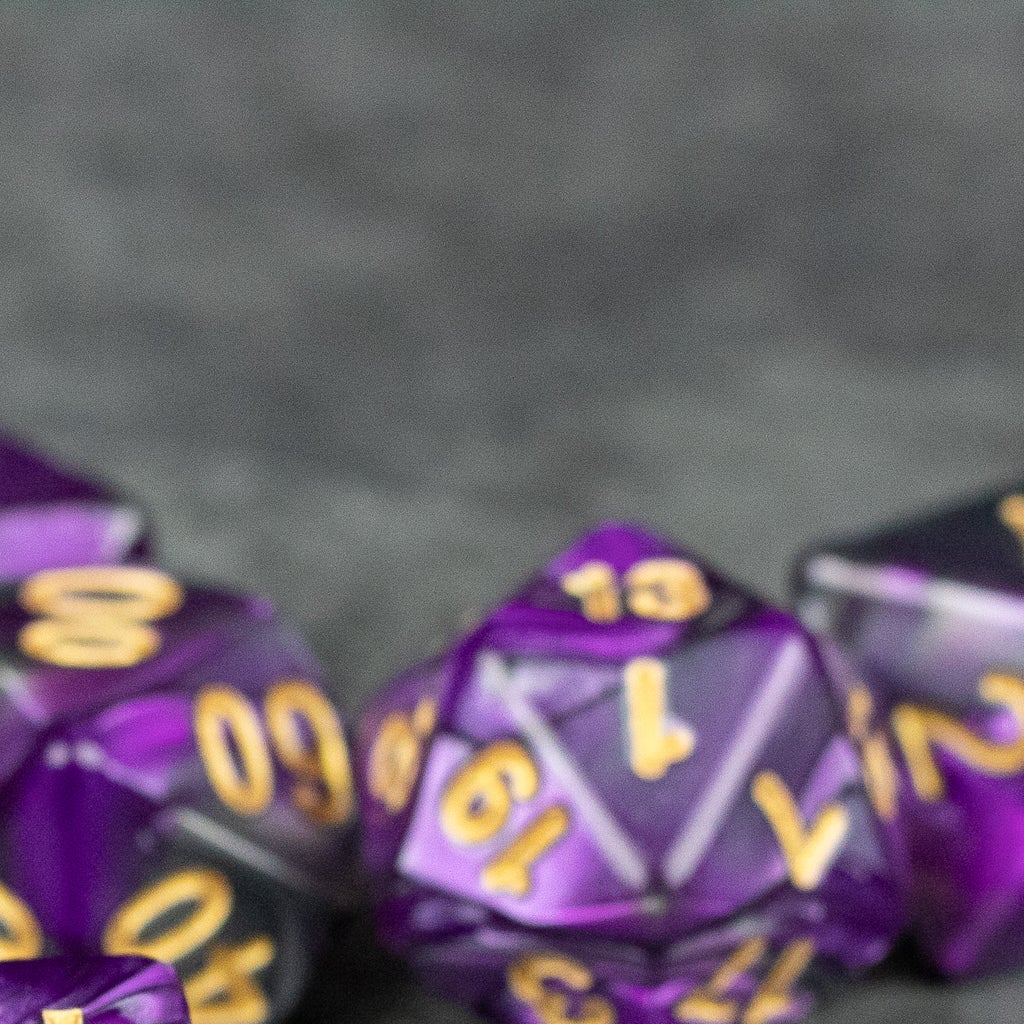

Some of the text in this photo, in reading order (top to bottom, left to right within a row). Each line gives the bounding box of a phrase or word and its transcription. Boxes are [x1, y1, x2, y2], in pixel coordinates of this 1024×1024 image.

[18, 566, 184, 668] 00
[626, 659, 693, 780] 1
[441, 741, 568, 896] 19
[752, 771, 848, 890] 7
